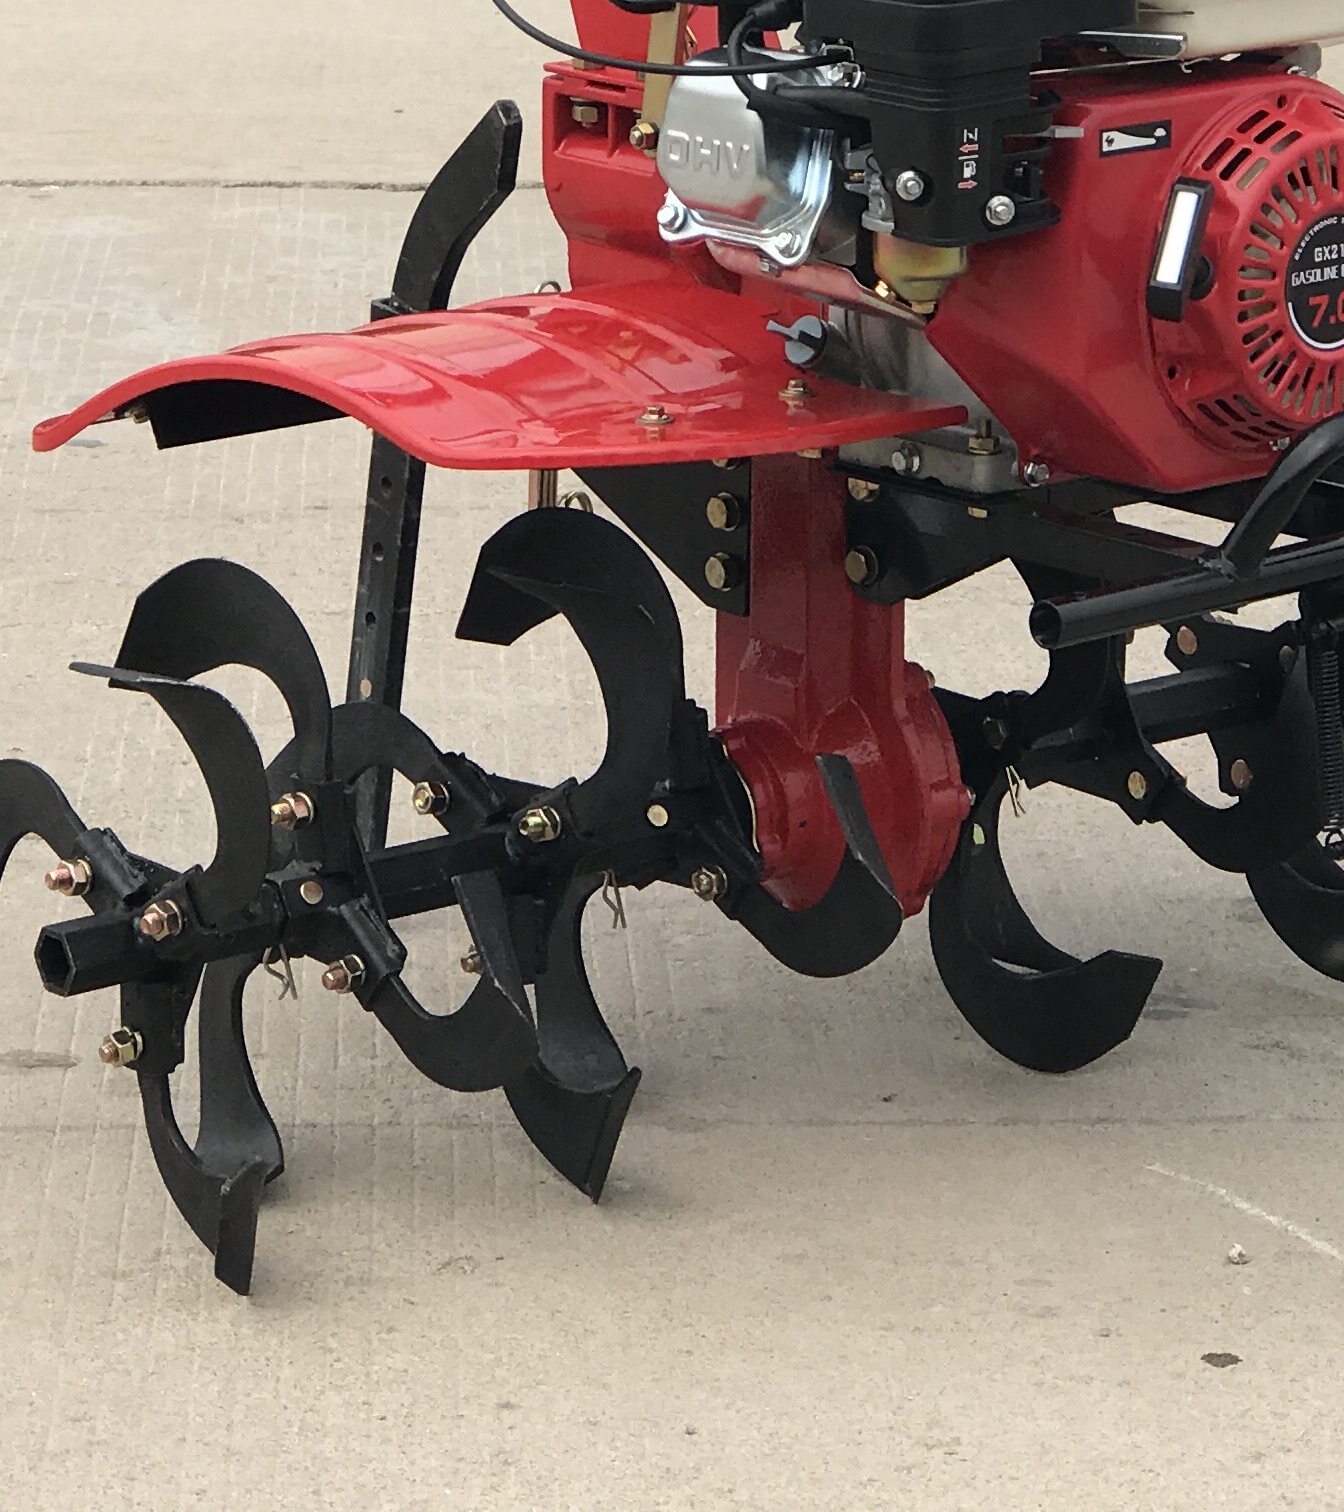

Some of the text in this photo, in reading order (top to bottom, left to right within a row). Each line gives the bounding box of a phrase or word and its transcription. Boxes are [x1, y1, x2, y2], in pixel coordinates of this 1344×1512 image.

[664, 128, 751, 180] OHV
[1294, 216, 1338, 261] ELECTRONIC
[1291, 264, 1339, 287] GASOLINE
